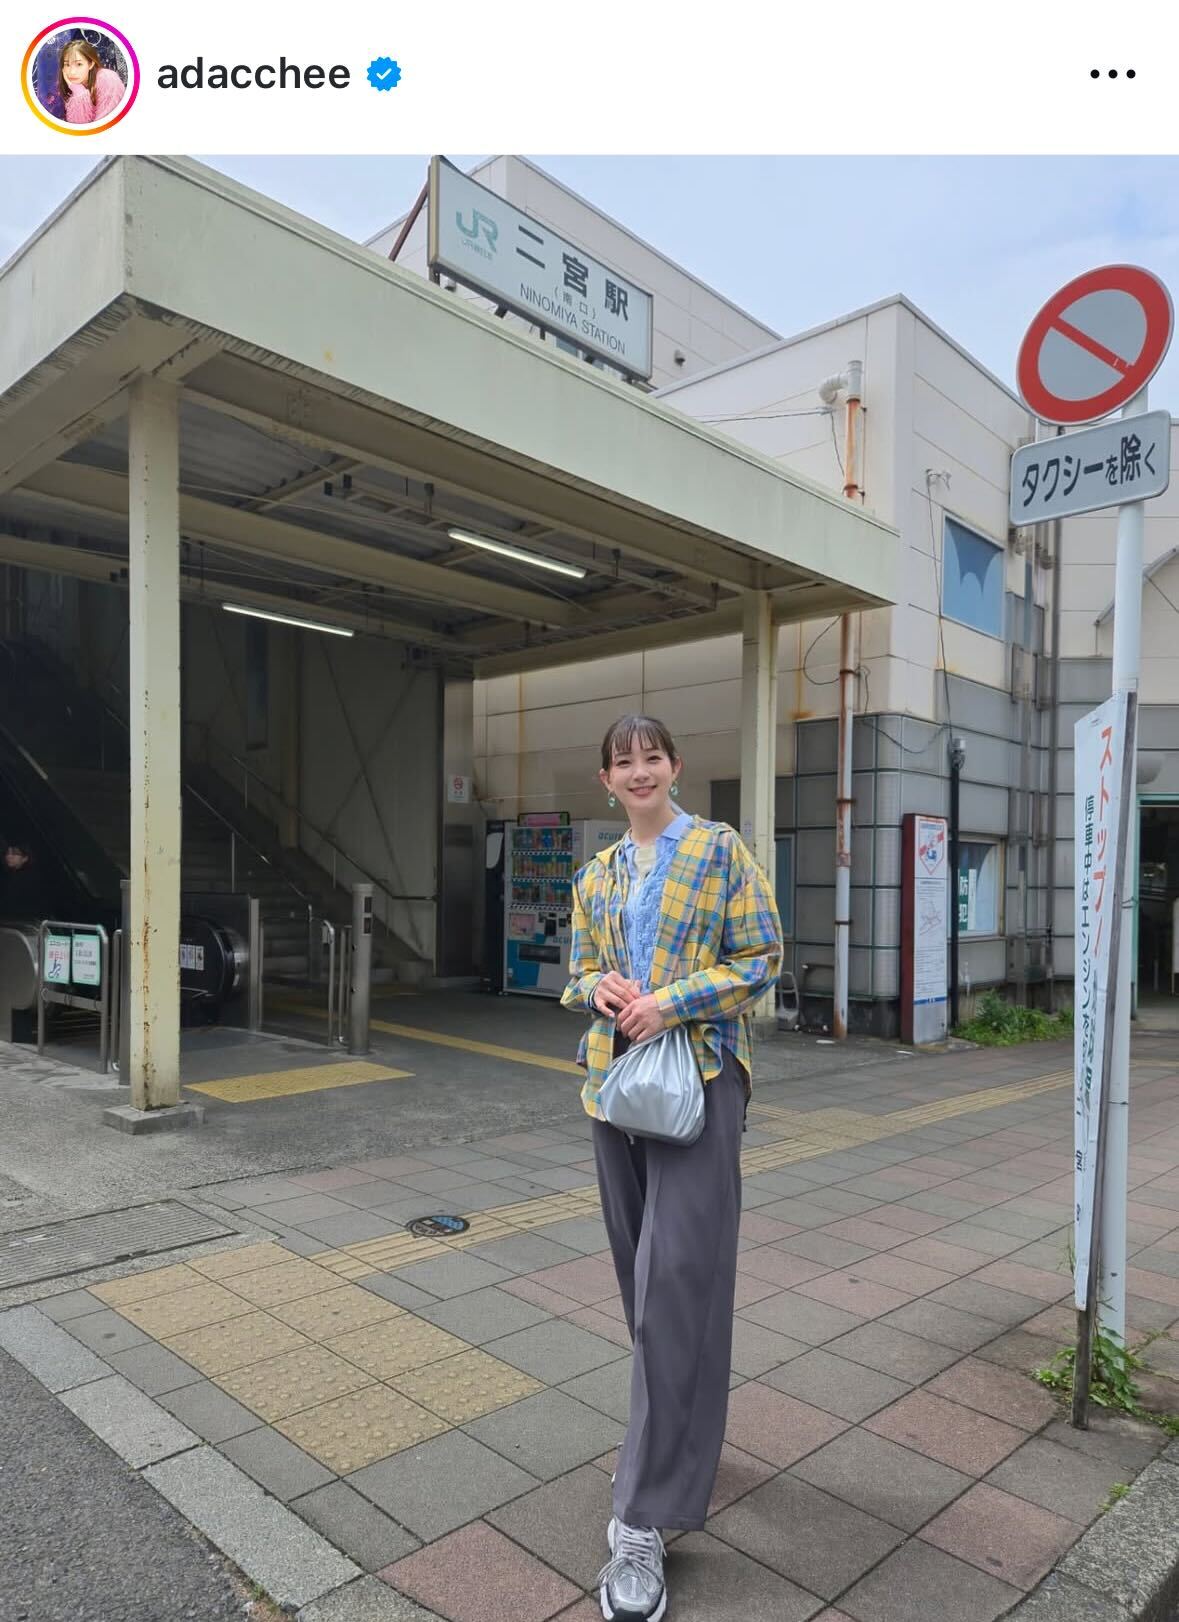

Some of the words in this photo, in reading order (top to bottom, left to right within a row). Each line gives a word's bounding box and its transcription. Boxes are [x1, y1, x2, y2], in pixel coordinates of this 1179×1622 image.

[455, 207, 499, 254] JR
[516, 225, 629, 322] 二宮駅
[520, 283, 578, 330] NINOMIYA
[582, 319, 626, 355] STATION
[1022, 433, 1155, 507] タクシーを除く
